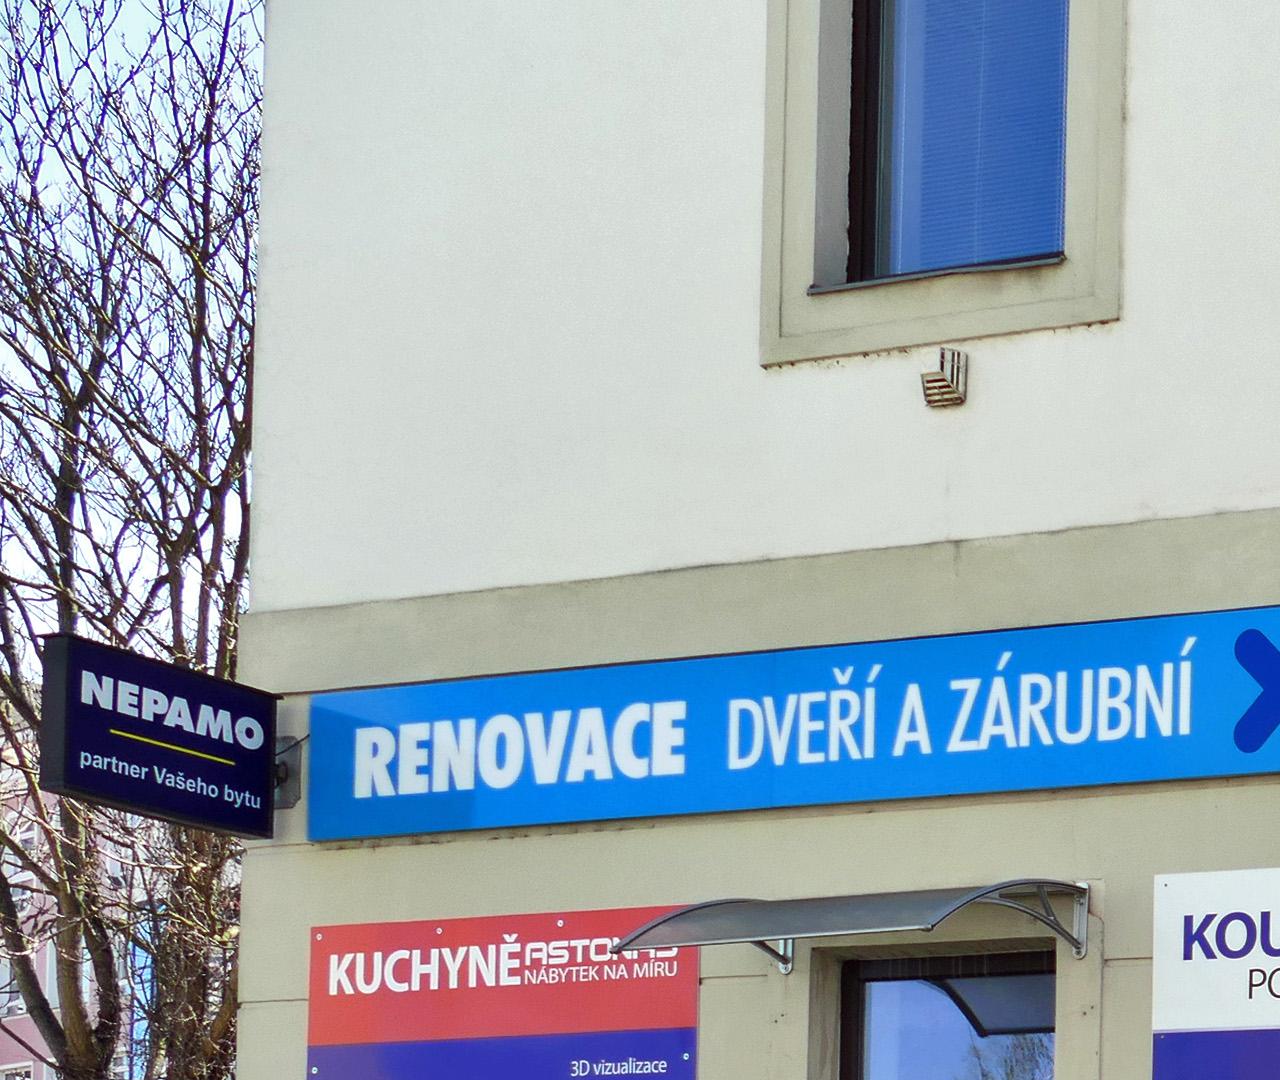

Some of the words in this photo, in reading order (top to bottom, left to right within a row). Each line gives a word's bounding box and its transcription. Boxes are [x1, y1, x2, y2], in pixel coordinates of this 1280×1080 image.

[80, 670, 264, 751] NEPAMO
[353, 700, 687, 799] RENOVACE
[726, 664, 879, 771] DVEŘÍ
[893, 696, 931, 758] A
[948, 637, 1197, 753] ZÁRUBNÍ
[80, 750, 148, 781] partner
[153, 766, 219, 798] Vašeho
[223, 783, 261, 810] bytu
[329, 934, 521, 996] KUCHYNĚ
[525, 965, 599, 985] NÁBYTEK
[604, 964, 628, 980] NA
[633, 959, 678, 978] MÍRU
[570, 1060, 589, 1077] 3D
[593, 1057, 667, 1076] vizualizace
